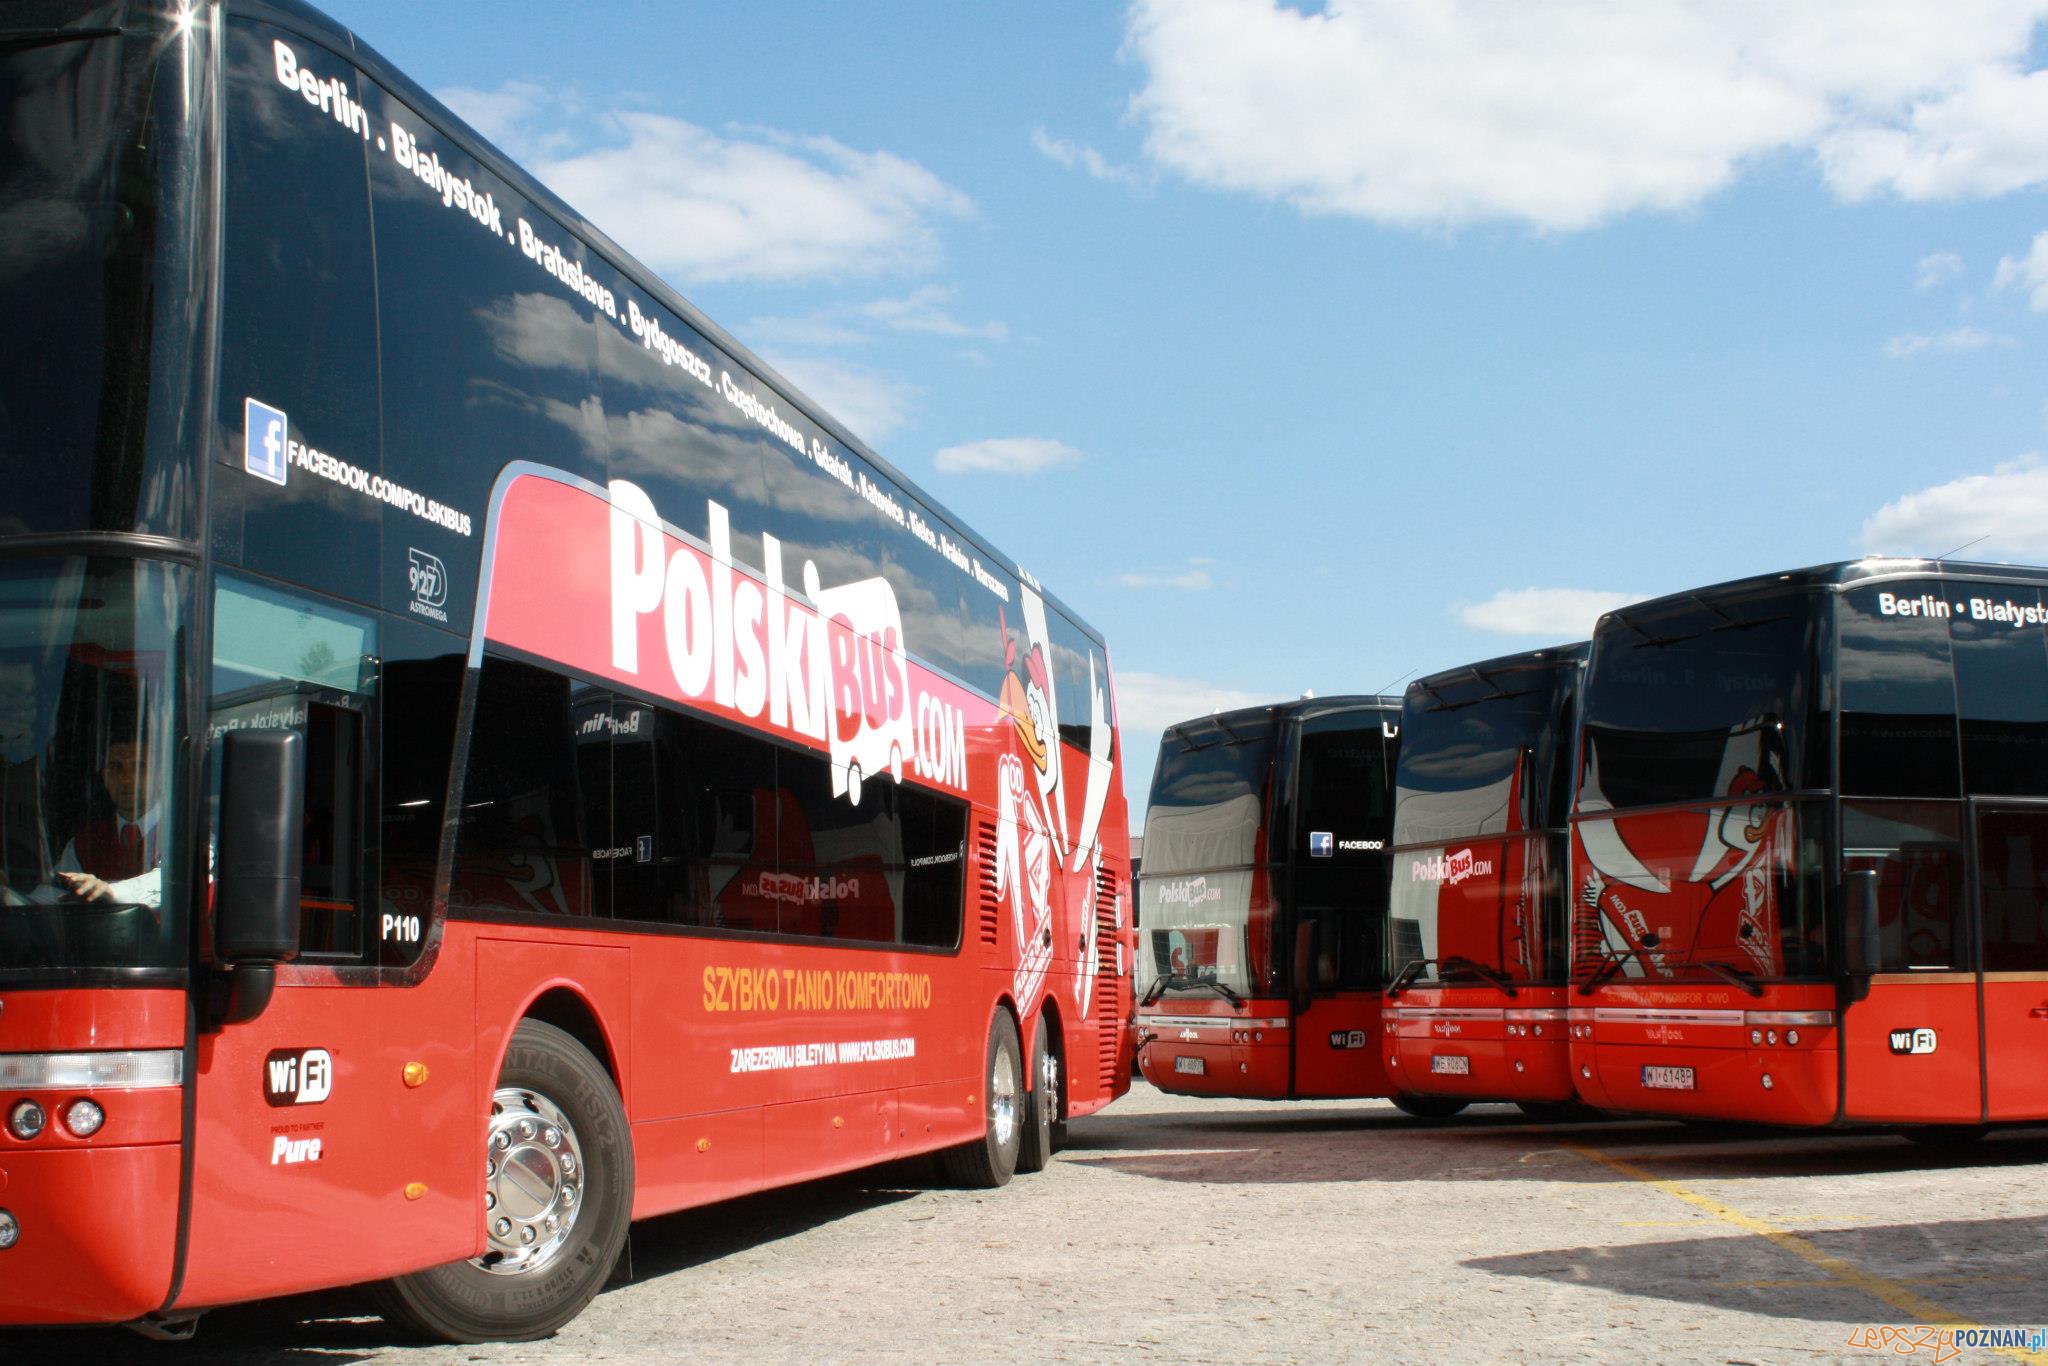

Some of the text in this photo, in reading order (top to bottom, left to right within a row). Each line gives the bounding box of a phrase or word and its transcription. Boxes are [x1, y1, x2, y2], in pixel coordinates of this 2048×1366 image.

[273, 39, 370, 140] Berlin
[391, 121, 503, 237] Białystok
[517, 217, 616, 319] Bratislava
[628, 299, 713, 388] Bydgoszcz
[409, 600, 448, 623] ASTROMEGA
[1879, 592, 1951, 618] Berlin
[1339, 840, 1383, 850] FACEBOO
[382, 913, 420, 942] P110
[703, 966, 931, 1012] SZYBKO TANIO KOMFORTOWO
[731, 1045, 795, 1073] ZAREZERWUJ
[795, 1043, 823, 1068] BILETY
[824, 1042, 837, 1064] NA
